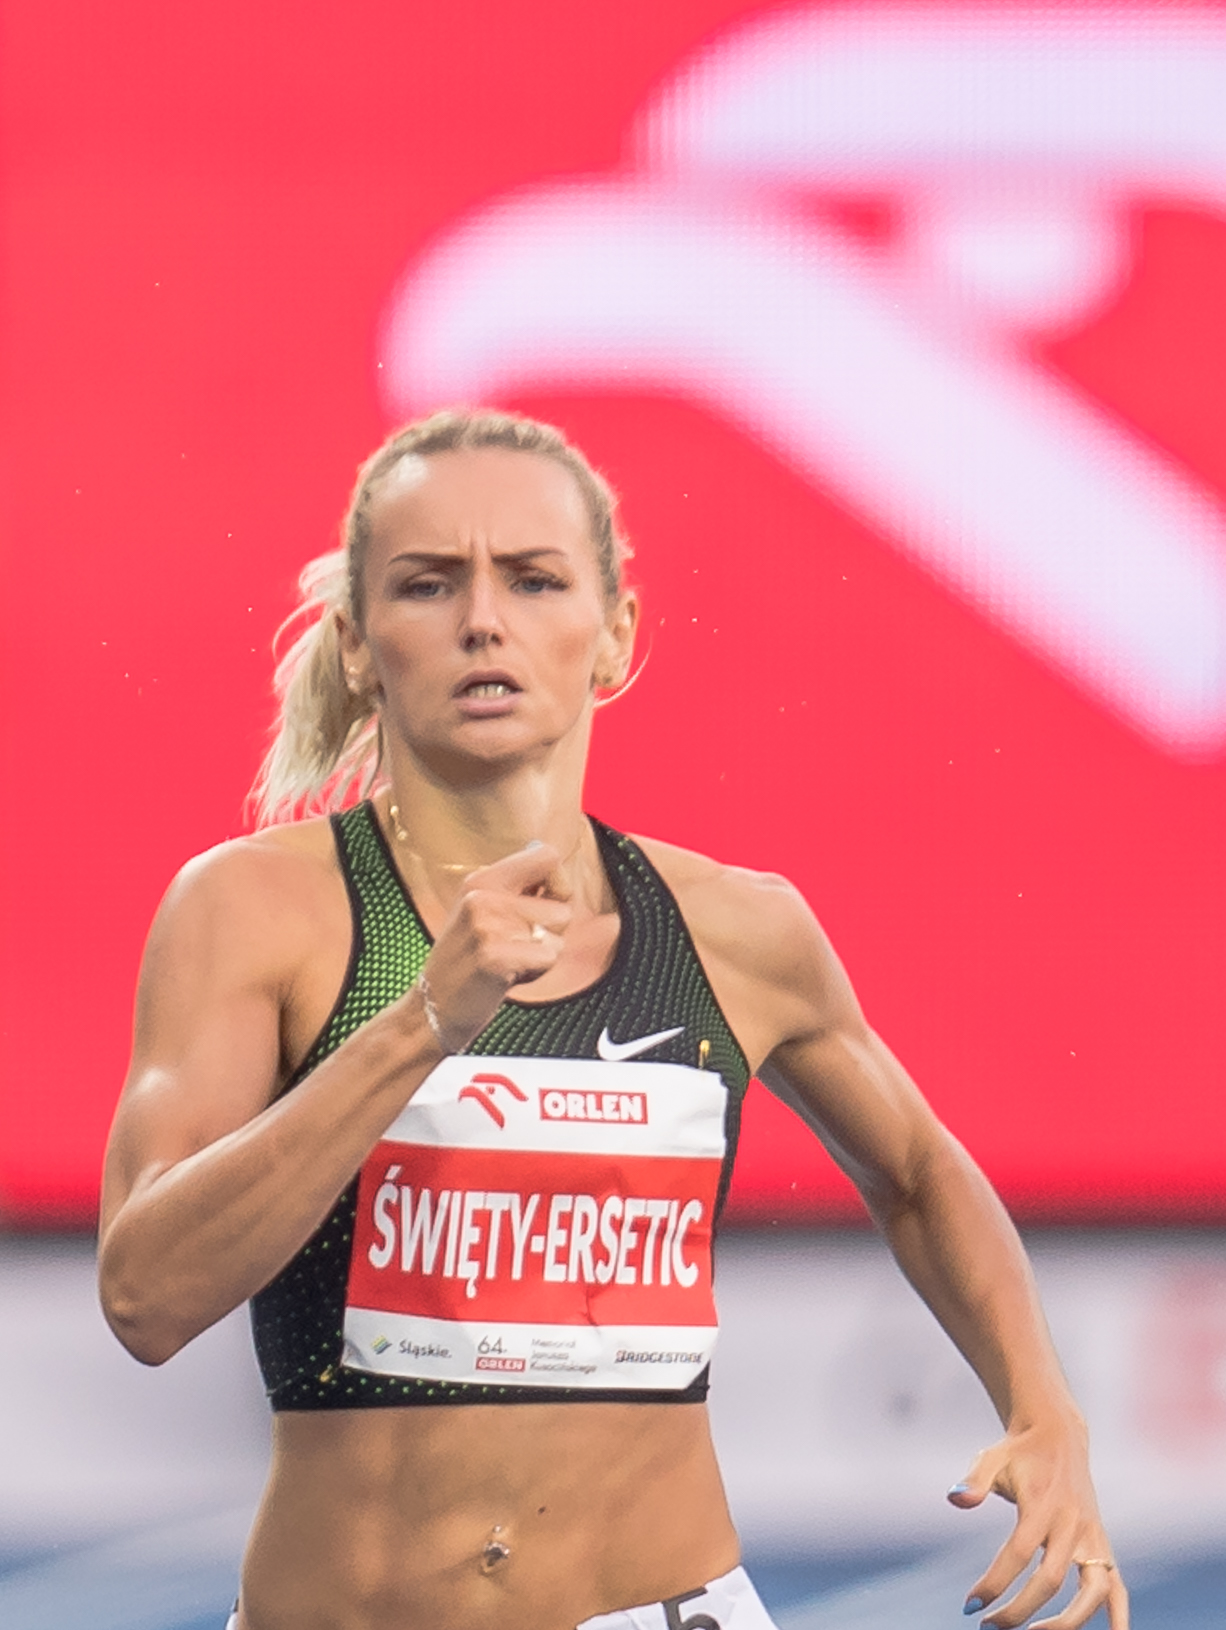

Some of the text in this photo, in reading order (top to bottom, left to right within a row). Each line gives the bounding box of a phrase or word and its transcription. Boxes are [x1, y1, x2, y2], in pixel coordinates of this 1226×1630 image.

[543, 1092, 642, 1121] ORLEN
[368, 1165, 702, 1299] ŚWIĘTY-ERSETIC
[477, 1358, 524, 1372] ORLEN
[615, 1350, 703, 1364] BRIDGESTONE
